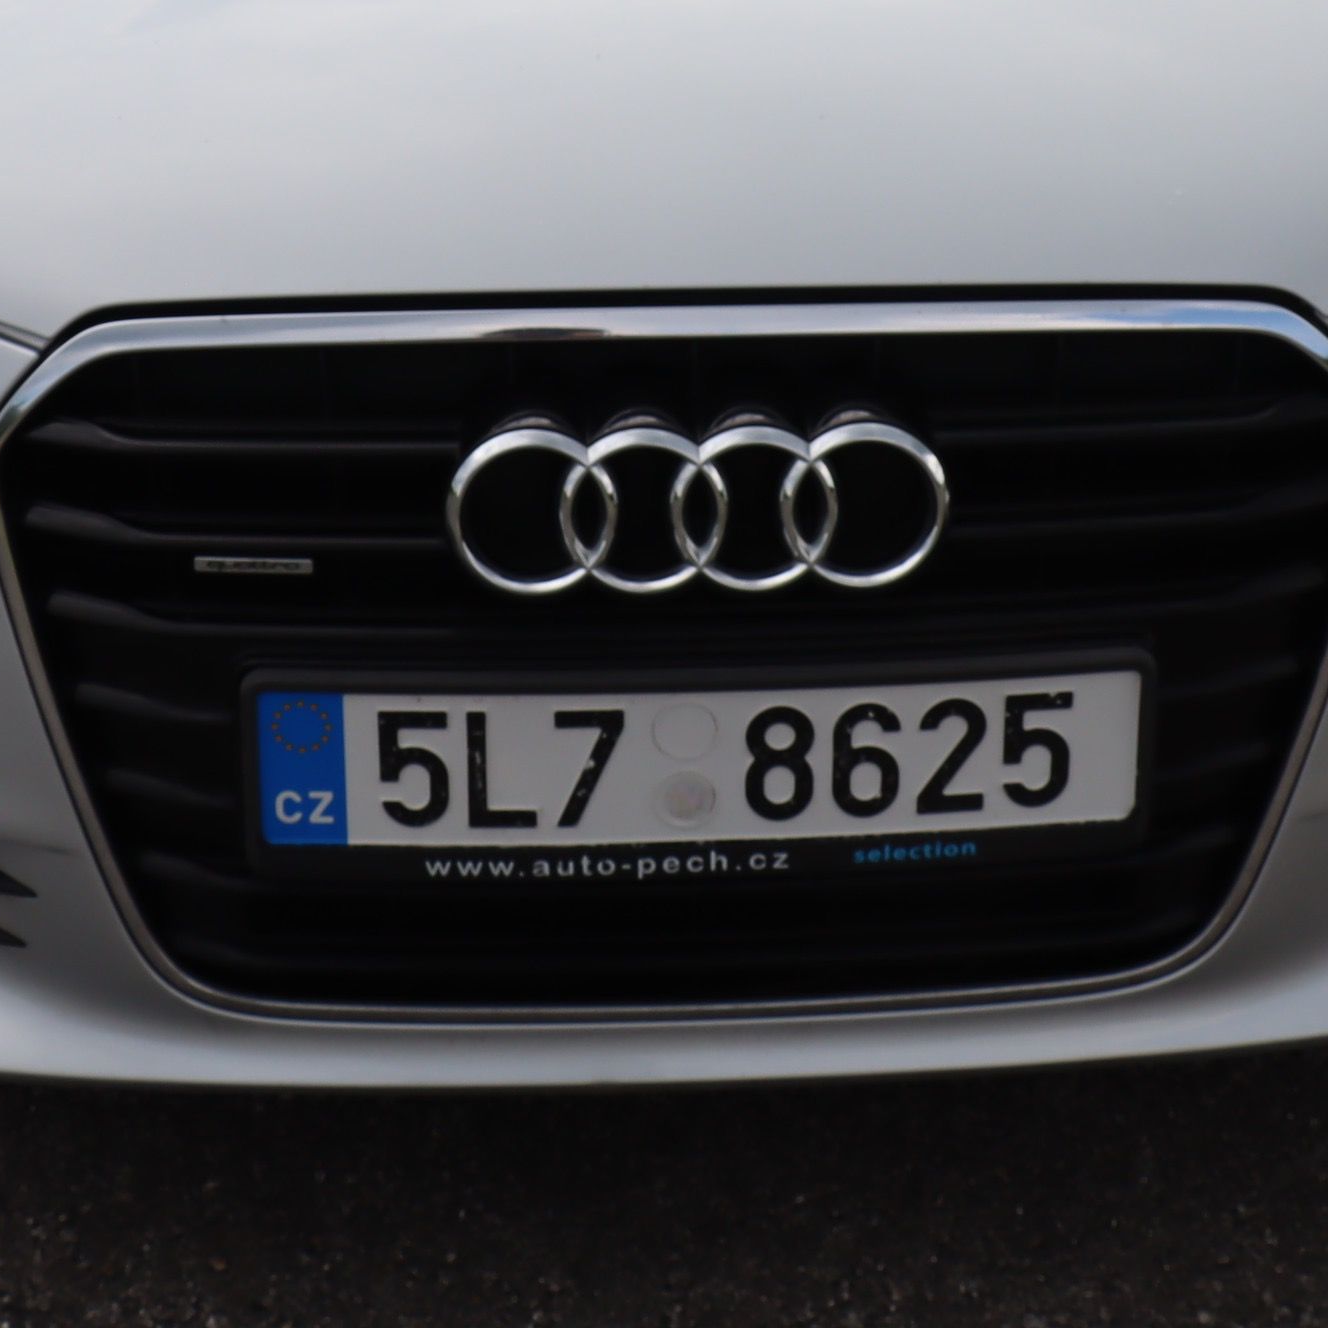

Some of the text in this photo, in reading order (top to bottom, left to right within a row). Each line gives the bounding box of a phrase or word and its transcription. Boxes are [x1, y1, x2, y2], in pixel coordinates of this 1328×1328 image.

[377, 693, 1074, 829] 5L7 8625
[275, 790, 335, 824] CZ
[425, 849, 789, 878] www.auto-pech.cz
[853, 840, 977, 864] selection
